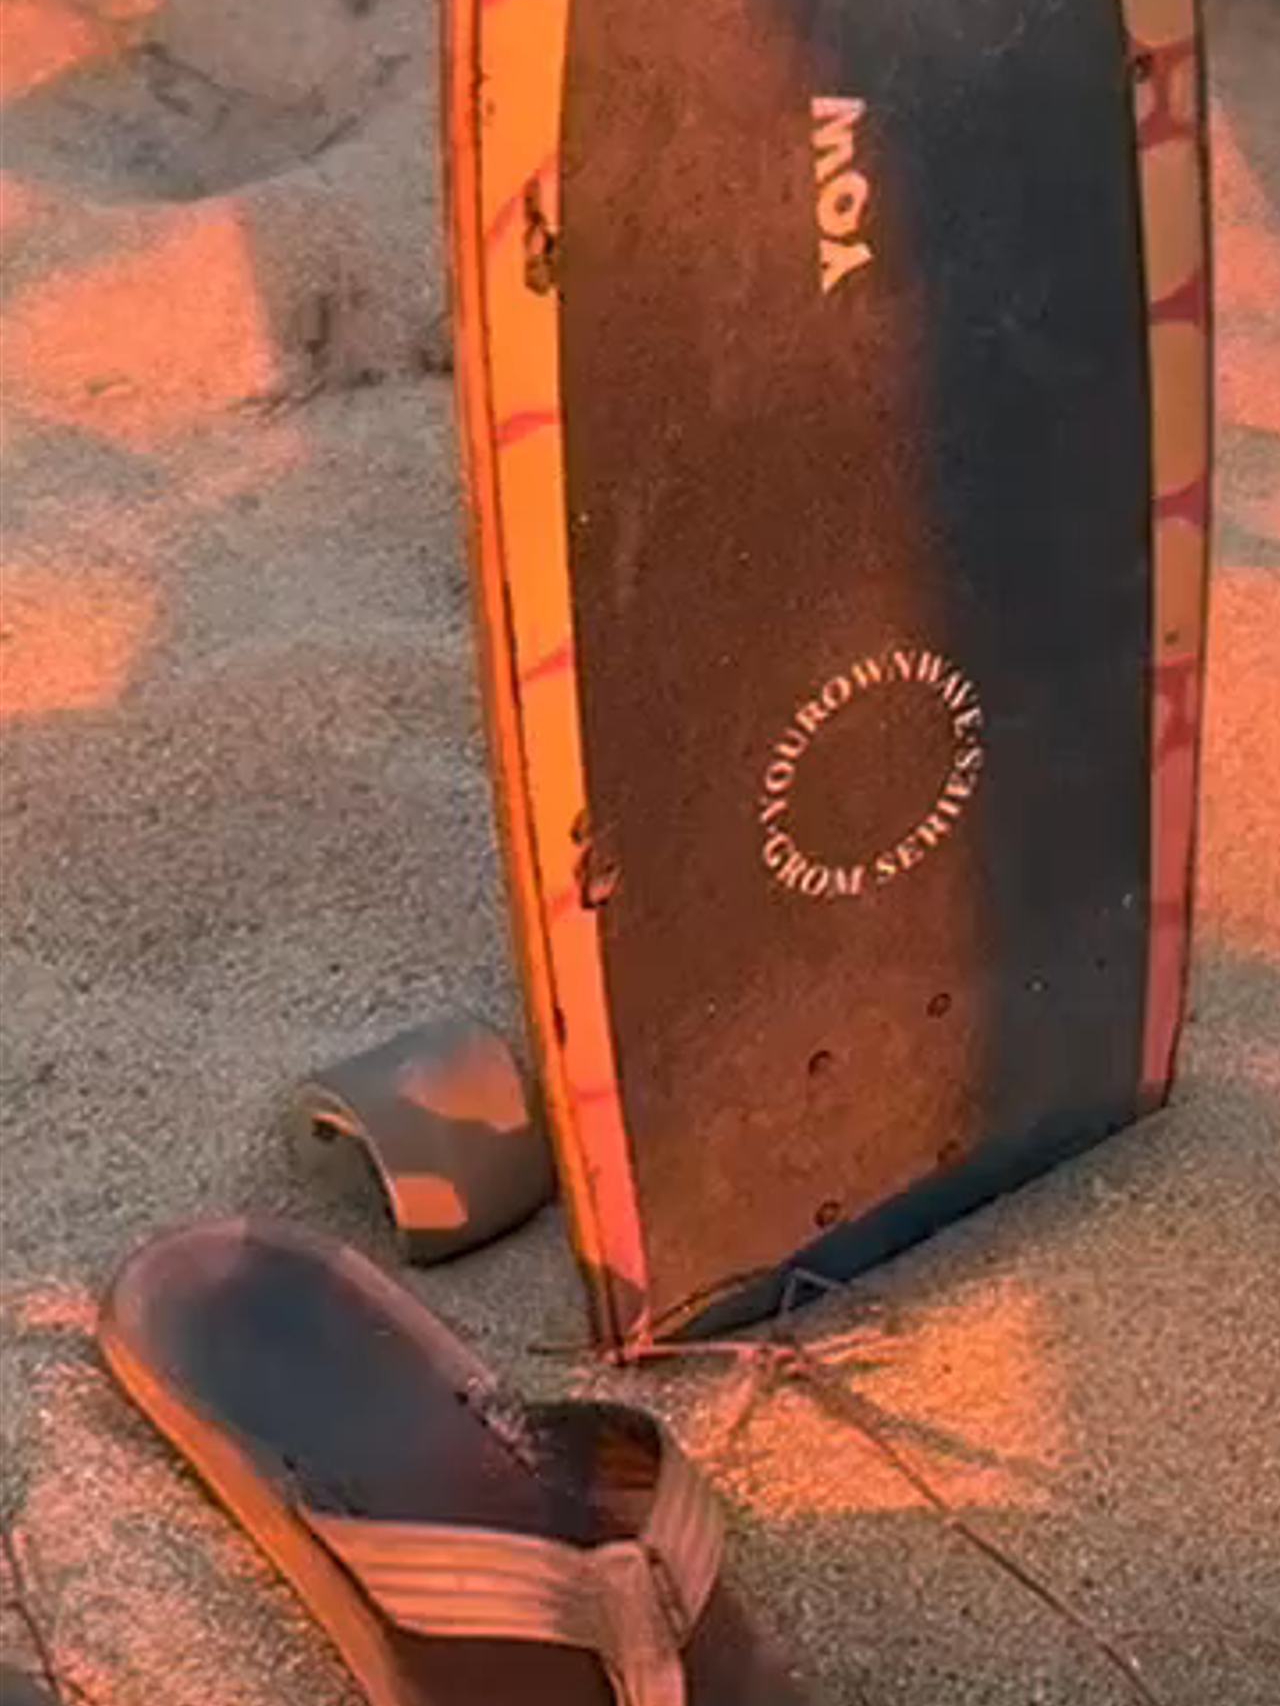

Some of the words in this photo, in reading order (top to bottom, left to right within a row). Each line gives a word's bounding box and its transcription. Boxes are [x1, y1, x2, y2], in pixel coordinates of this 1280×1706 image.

[811, 96, 873, 293] YOW
[763, 833, 865, 896] GROM
[873, 746, 983, 884] SERIES
